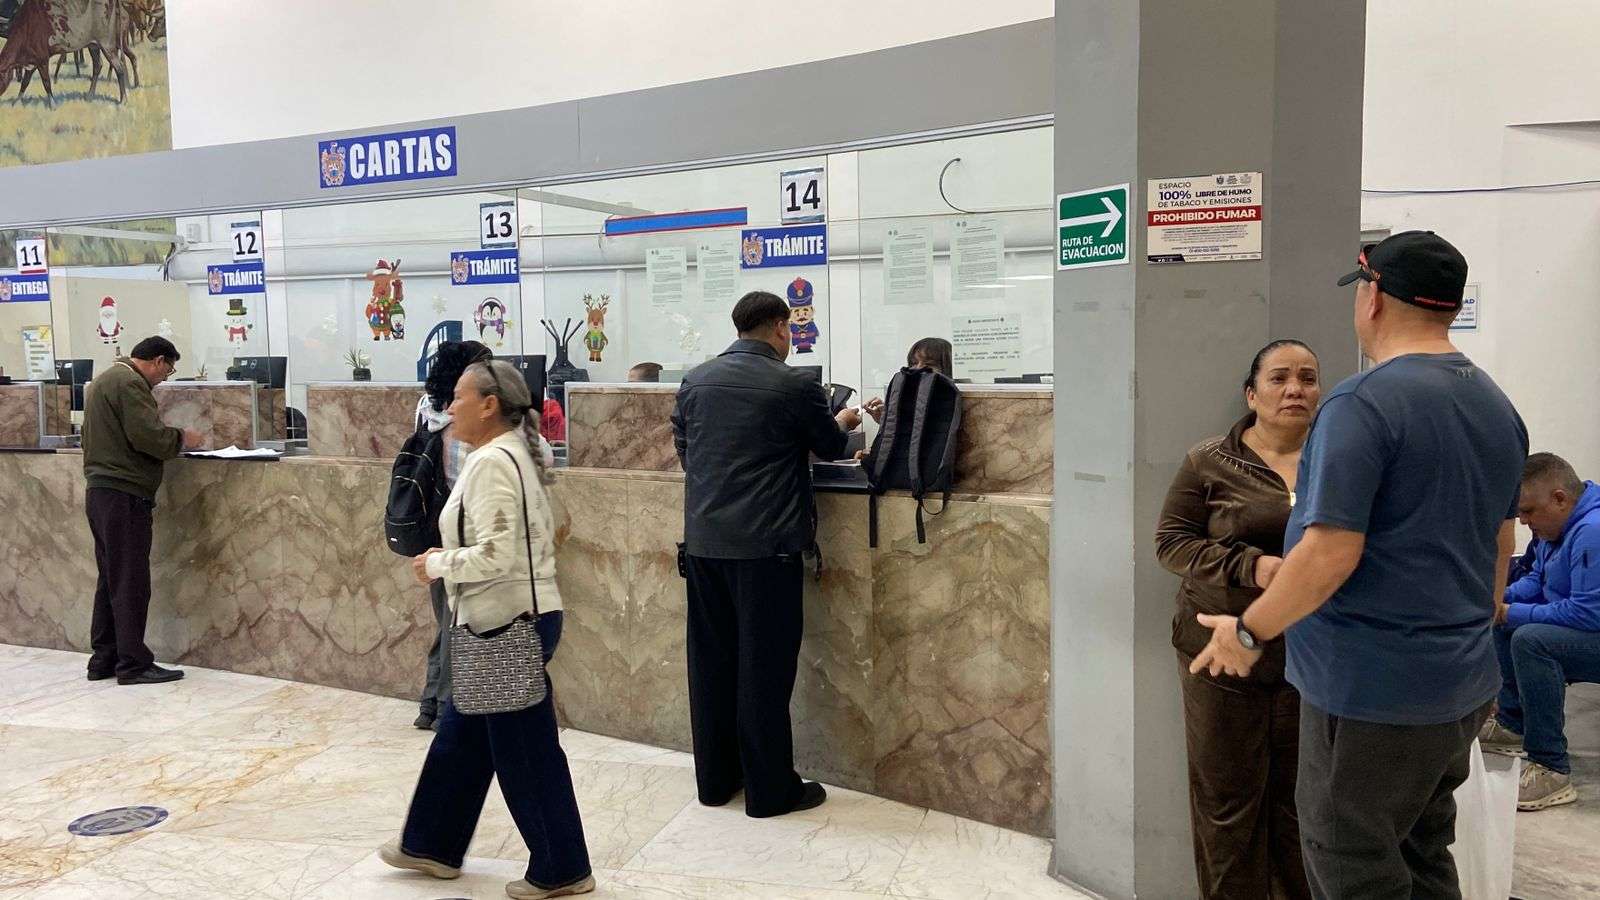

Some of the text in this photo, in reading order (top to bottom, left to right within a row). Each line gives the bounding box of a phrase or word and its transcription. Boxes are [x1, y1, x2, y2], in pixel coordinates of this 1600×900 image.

[349, 133, 452, 179] CARTAS
[1158, 181, 1191, 190] ESPACIO
[1159, 188, 1252, 200] 100% LIBRE DE HUMO
[785, 179, 821, 212] 14
[1171, 199, 1201, 208] TABACO
[1209, 196, 1252, 206] EMISIONES
[485, 211, 512, 239] 13
[1153, 208, 1256, 223] PROHIBIDO FUMAR
[234, 231, 258, 255] 12
[765, 234, 824, 257] TRÁMITE
[1062, 235, 1094, 248] RUTA DE
[1062, 242, 1124, 260] EVACUACION
[20, 245, 42, 267] 11
[470, 256, 517, 276] TRÁMITE
[223, 268, 264, 287] TRÁMITE
[12, 280, 49, 296] ENTREGA
